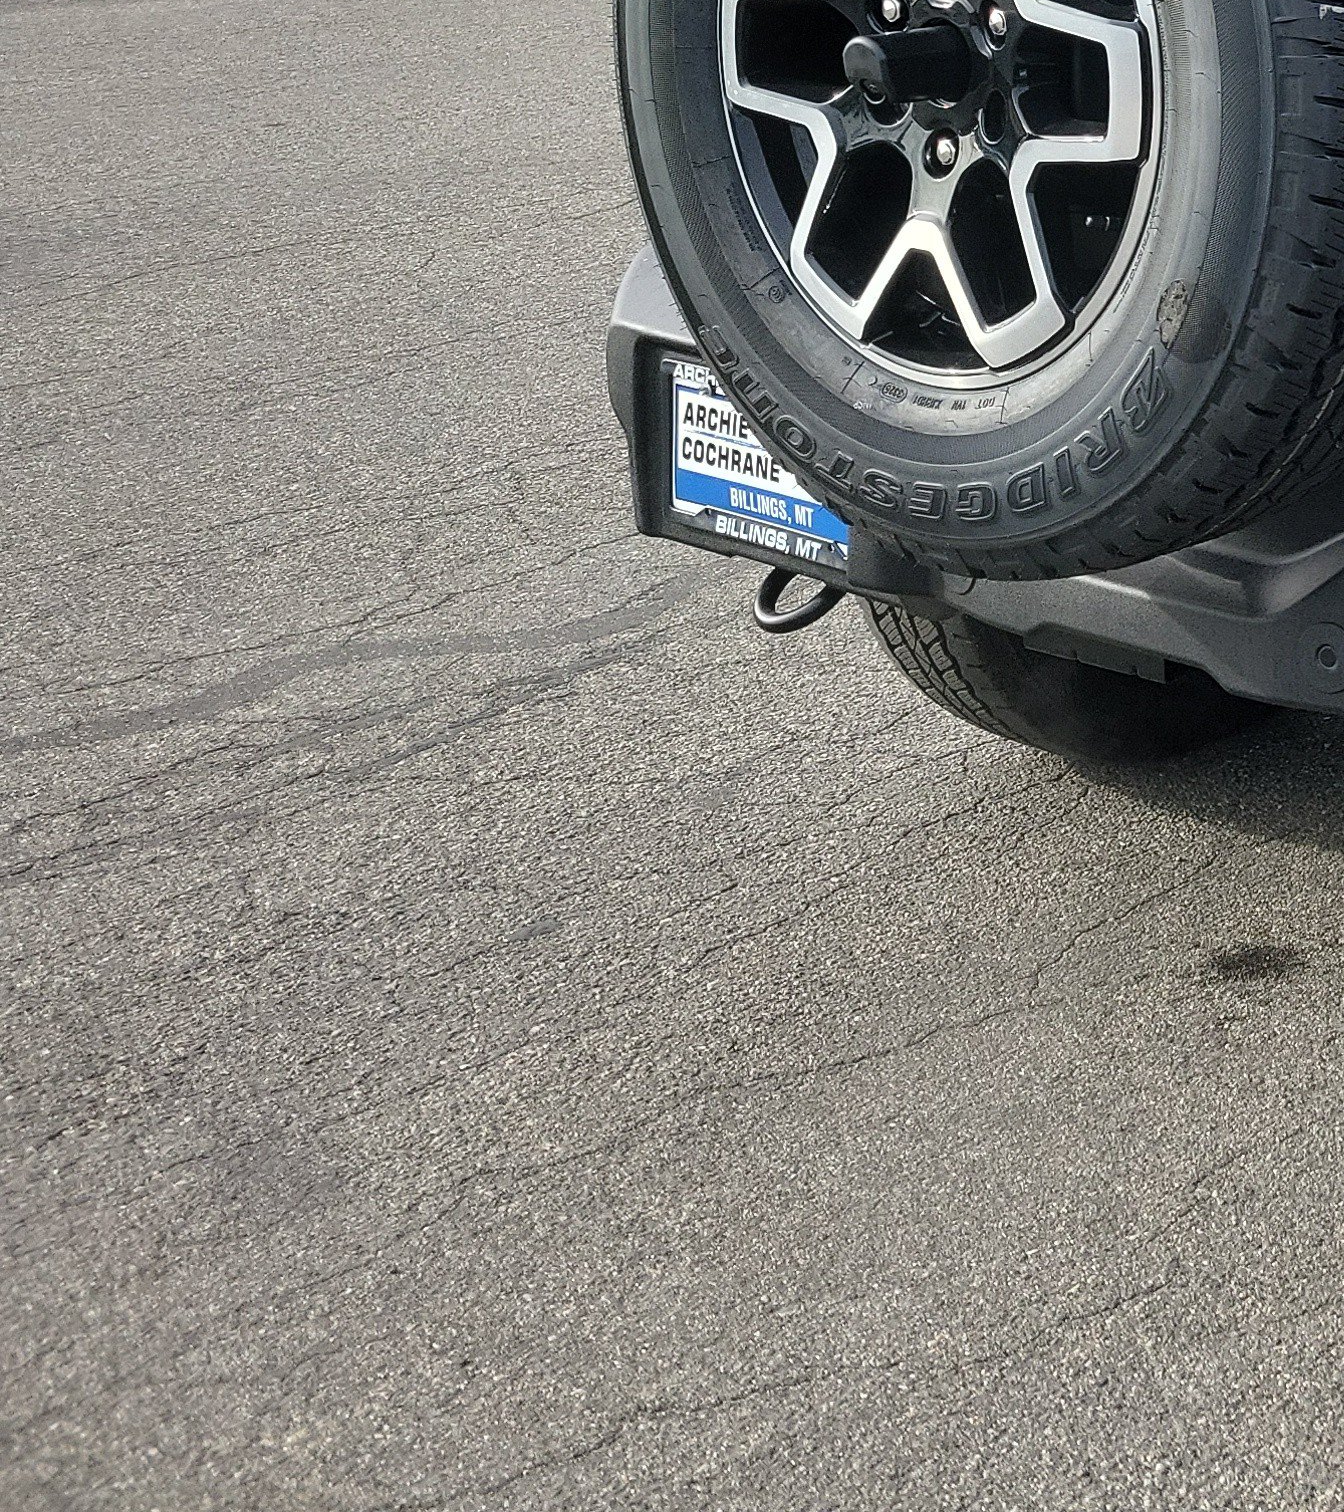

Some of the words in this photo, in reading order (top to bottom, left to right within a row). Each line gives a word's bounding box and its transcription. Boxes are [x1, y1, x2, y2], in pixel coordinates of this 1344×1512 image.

[683, 402, 749, 439] ARCHIE
[698, 322, 1169, 521] BRIDGESTONE
[682, 436, 780, 483] COCHRANE
[729, 487, 792, 524] BILLINGS,
[794, 503, 815, 528] MT
[715, 516, 790, 555] BILLINGS,
[795, 536, 823, 561] MT
